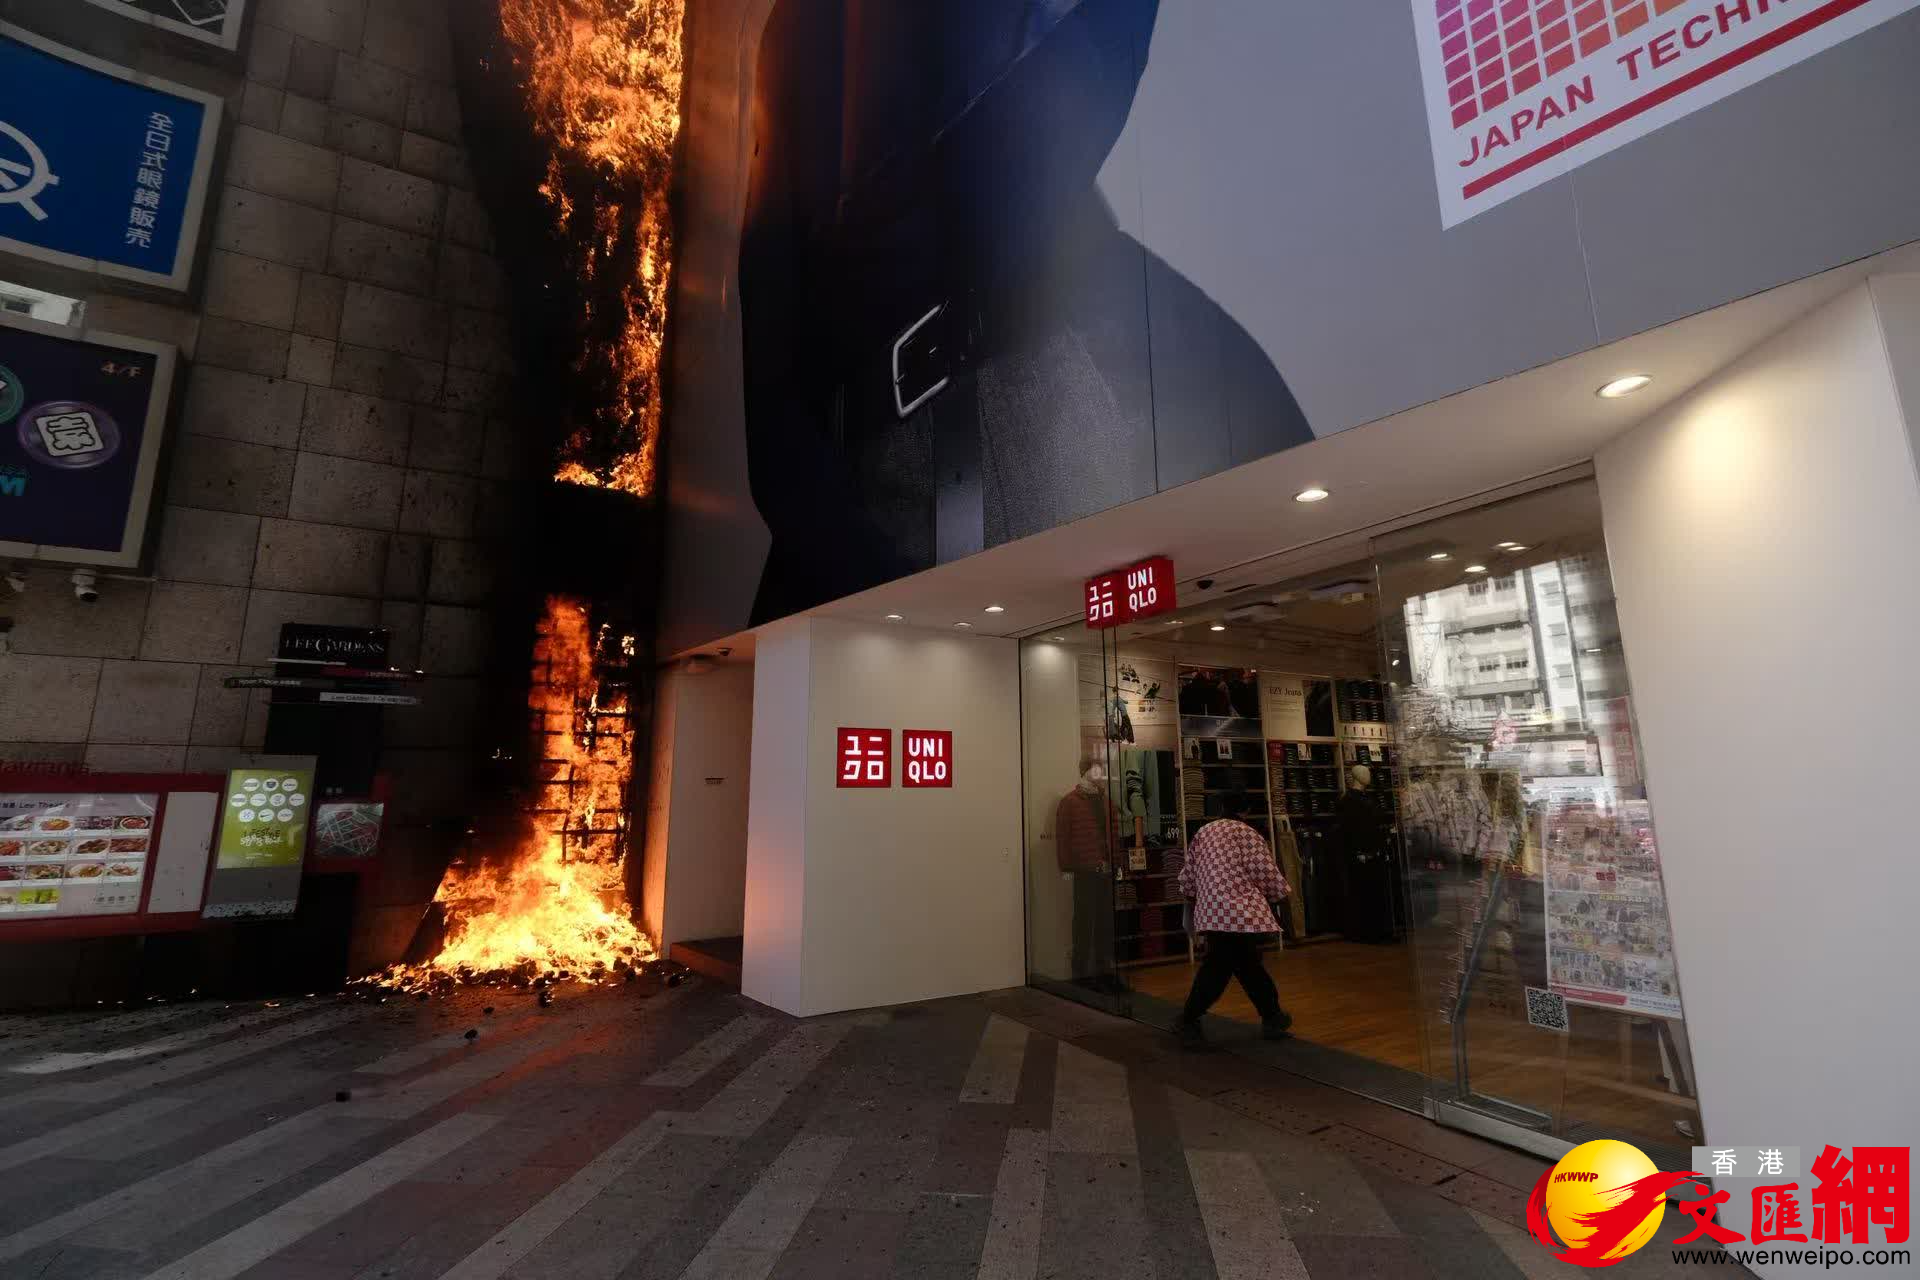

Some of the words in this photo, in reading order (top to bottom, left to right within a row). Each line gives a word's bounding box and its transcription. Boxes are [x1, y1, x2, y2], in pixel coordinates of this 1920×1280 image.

[1459, 76, 1594, 167] JAPAN
[125, 112, 174, 248] 全日式眼鏡販売
[1127, 566, 1153, 590] UNI
[1128, 587, 1157, 612] QLO
[908, 738, 943, 757] UNI
[908, 761, 946, 783] QLO
